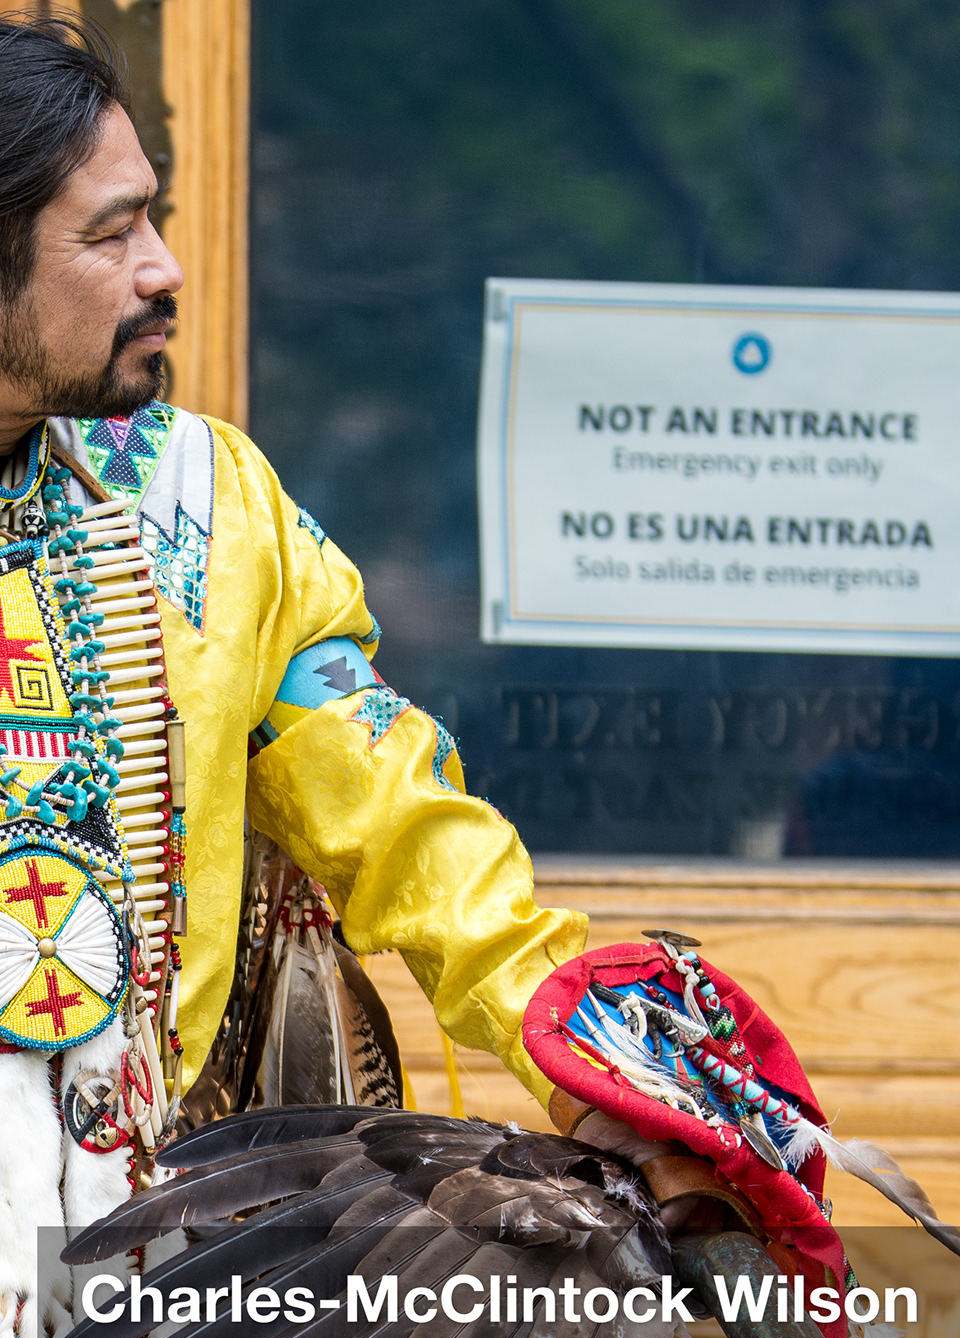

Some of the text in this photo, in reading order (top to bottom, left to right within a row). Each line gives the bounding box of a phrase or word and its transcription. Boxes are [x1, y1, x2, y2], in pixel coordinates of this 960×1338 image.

[578, 404, 918, 441] NOT AN ENTRANCE
[613, 447, 883, 486] Emergency exit only
[561, 511, 933, 548] NO ES UNA ENTRADA
[575, 555, 920, 593] Solo salida de emergencia
